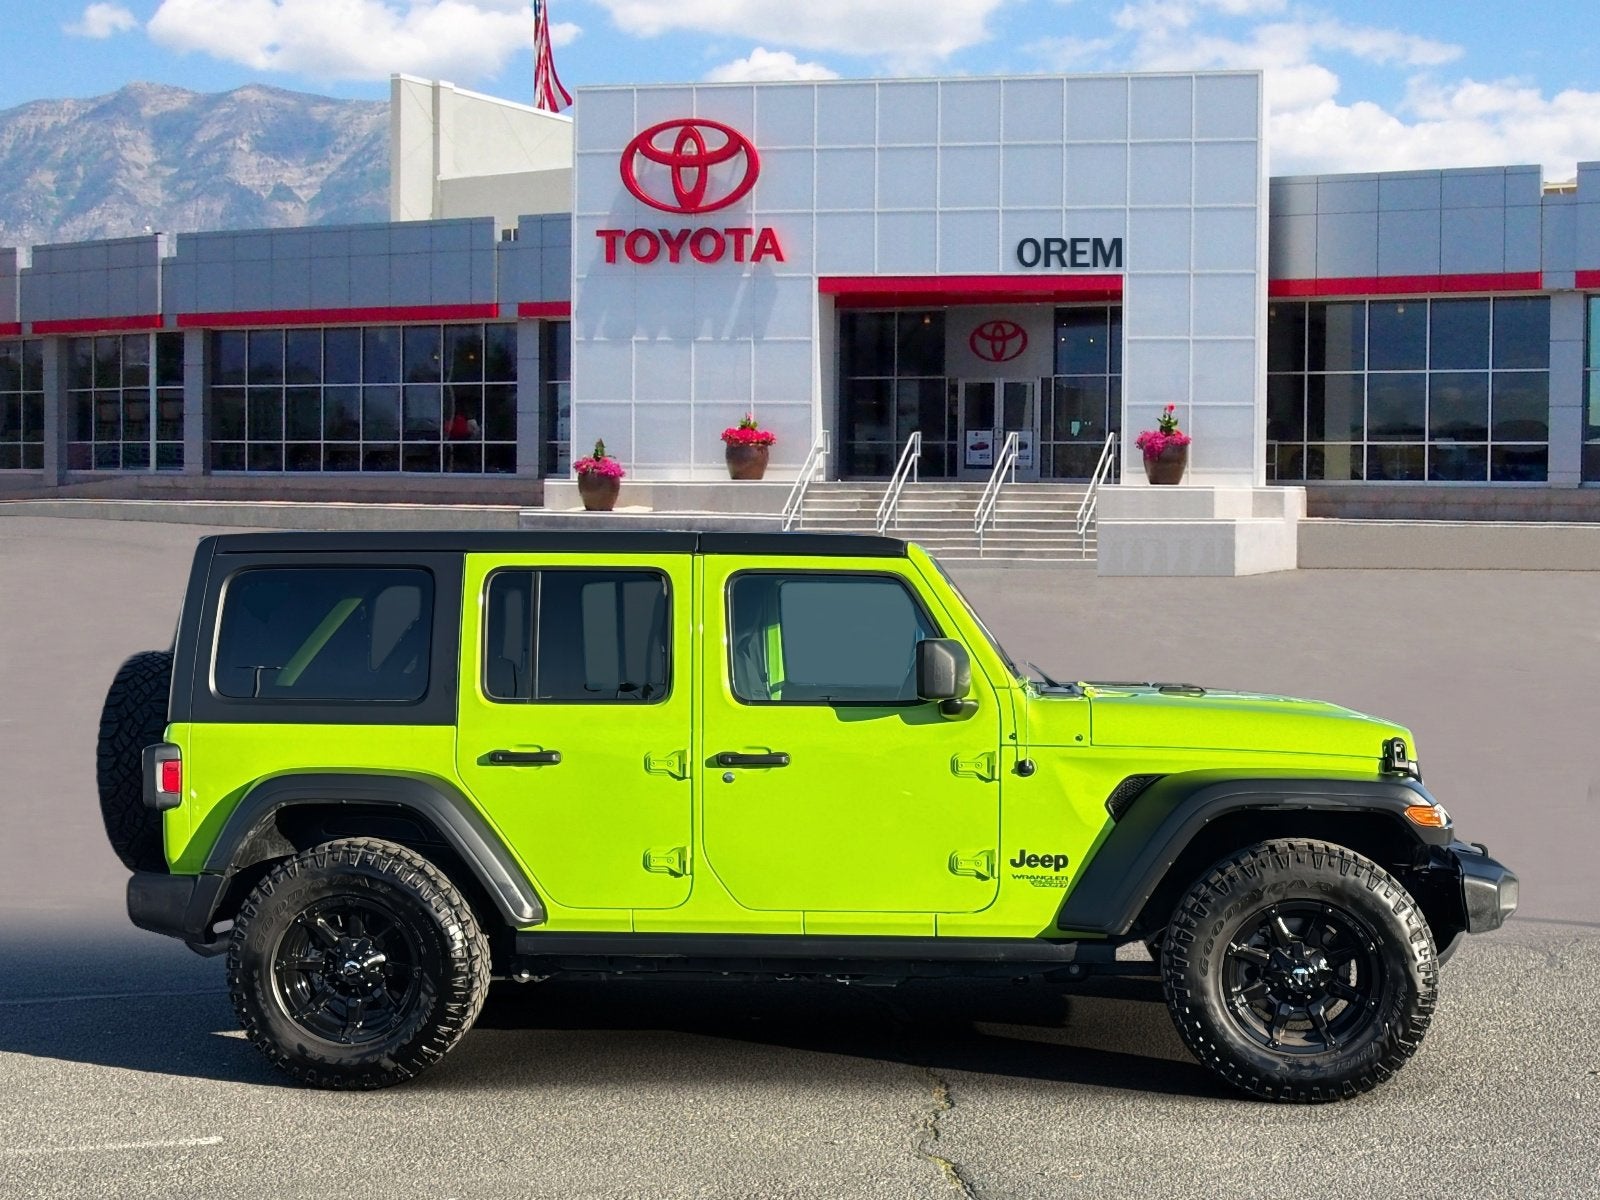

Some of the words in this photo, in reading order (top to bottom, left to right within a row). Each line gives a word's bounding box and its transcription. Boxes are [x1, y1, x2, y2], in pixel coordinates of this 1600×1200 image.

[596, 227, 785, 264] TOYOTA
[1017, 238, 1122, 267] OREM
[1010, 849, 1069, 872] Jeep
